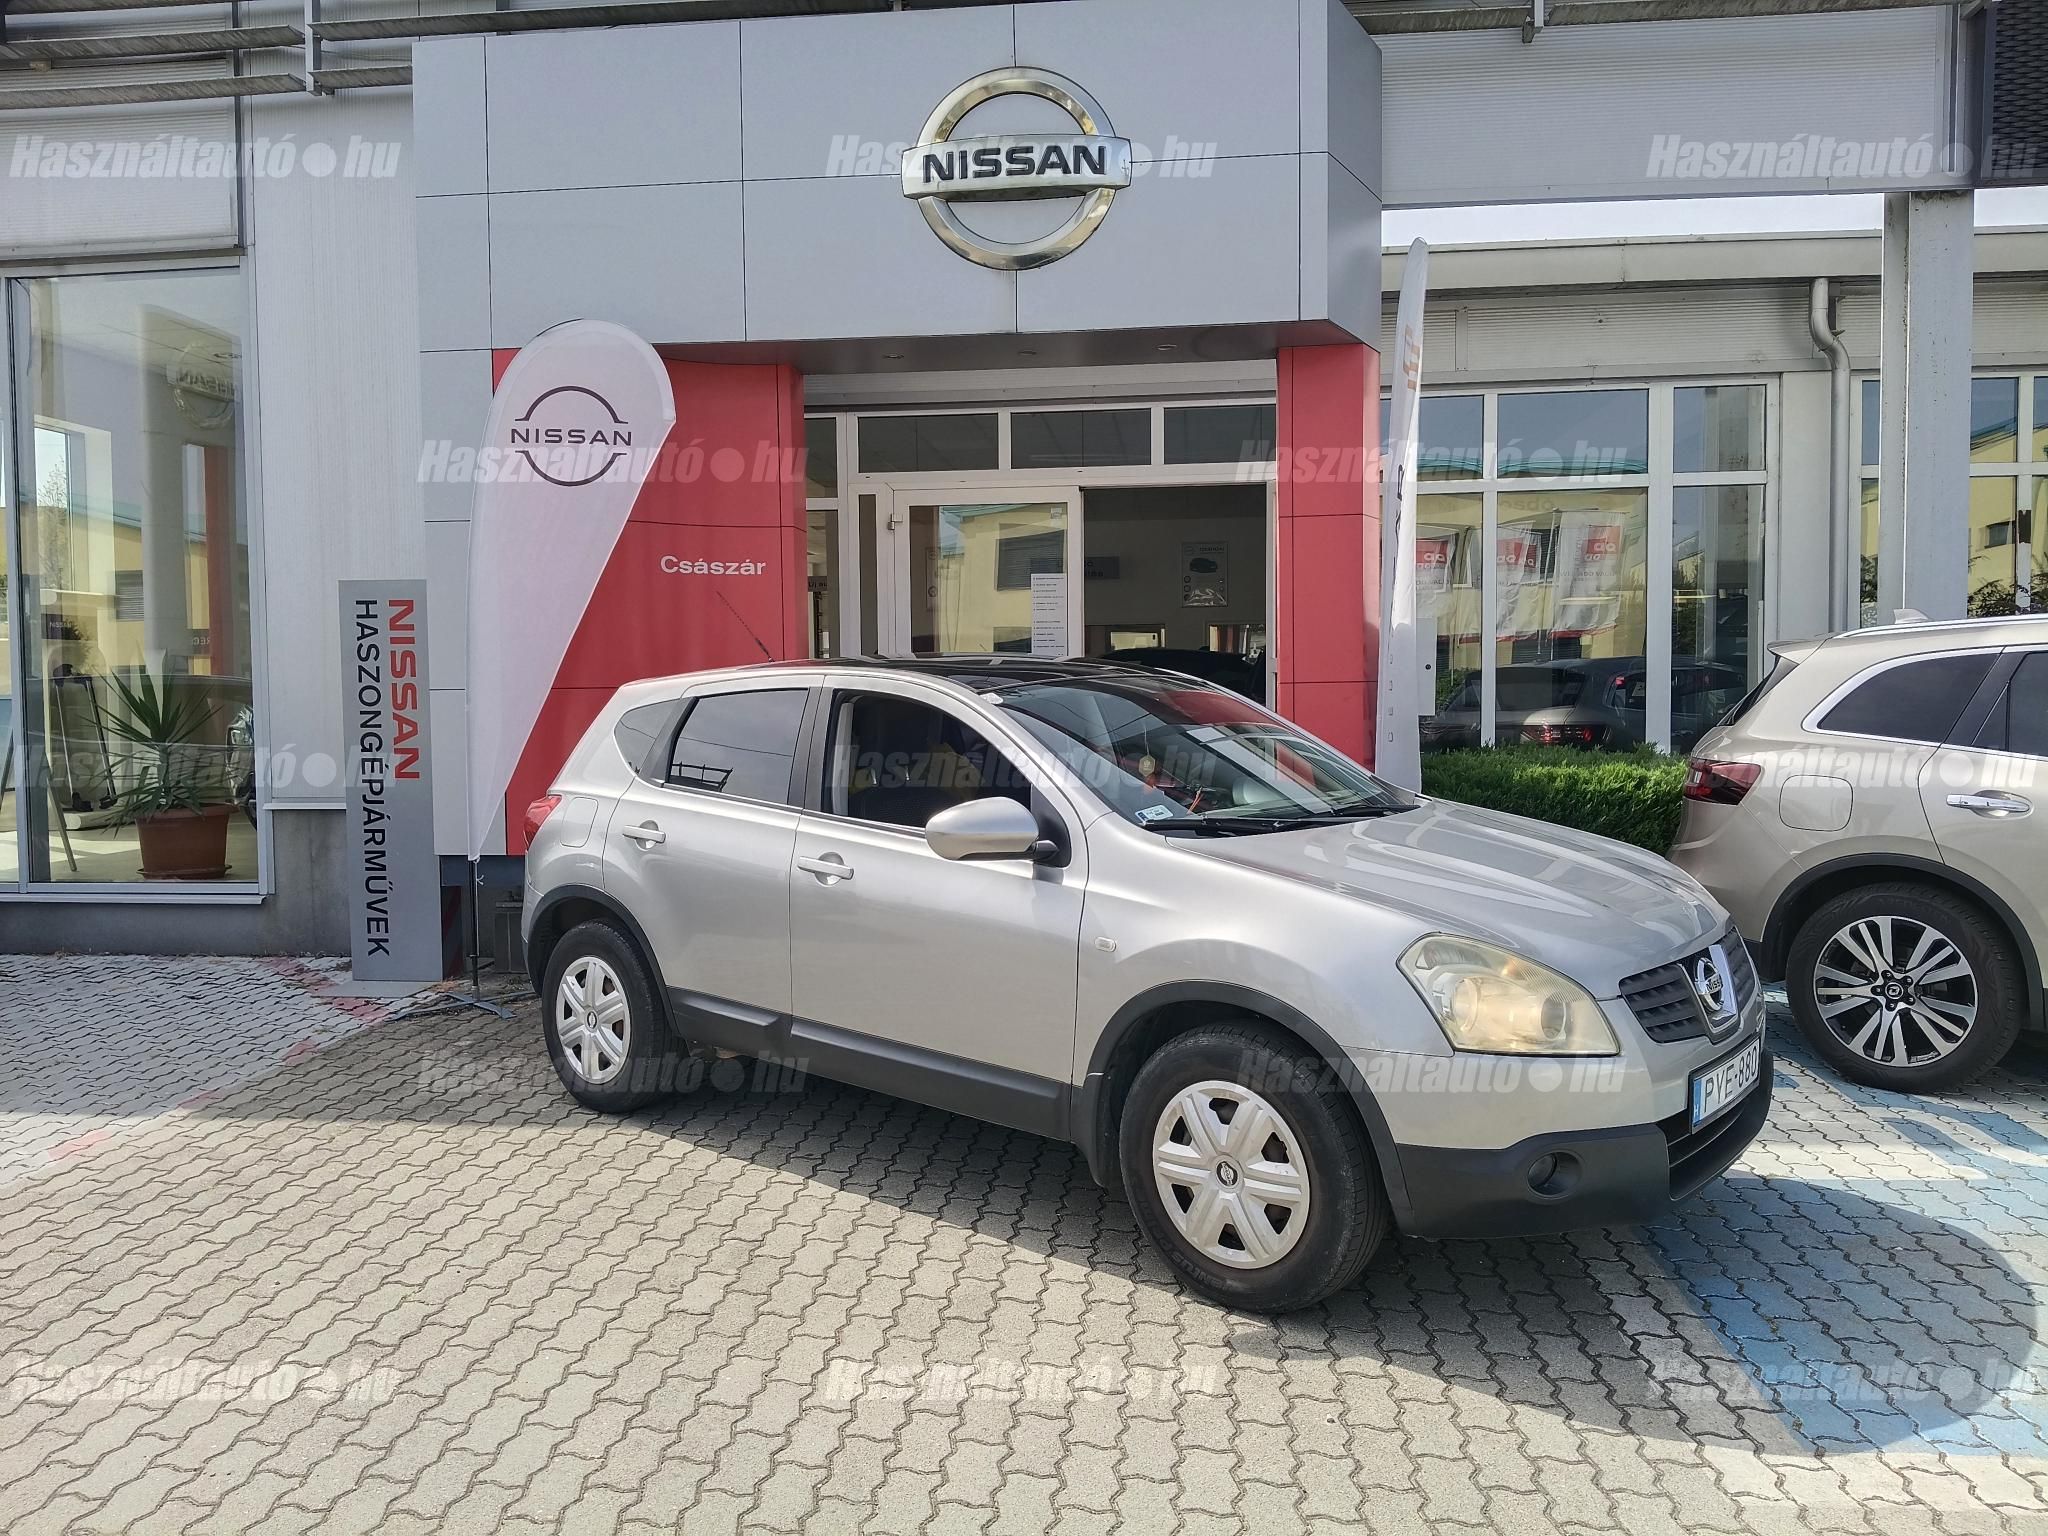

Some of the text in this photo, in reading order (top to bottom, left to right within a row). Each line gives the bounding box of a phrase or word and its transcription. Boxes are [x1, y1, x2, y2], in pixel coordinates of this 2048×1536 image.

[922, 145, 1106, 183] NISSAN
[511, 427, 633, 446] NISSAN
[660, 555, 766, 576] Császár
[388, 598, 421, 780] NISSAN
[355, 599, 391, 957] HASZONGÉPJÁRMŰVEK
[1704, 1046, 1758, 1114] PYE-880
